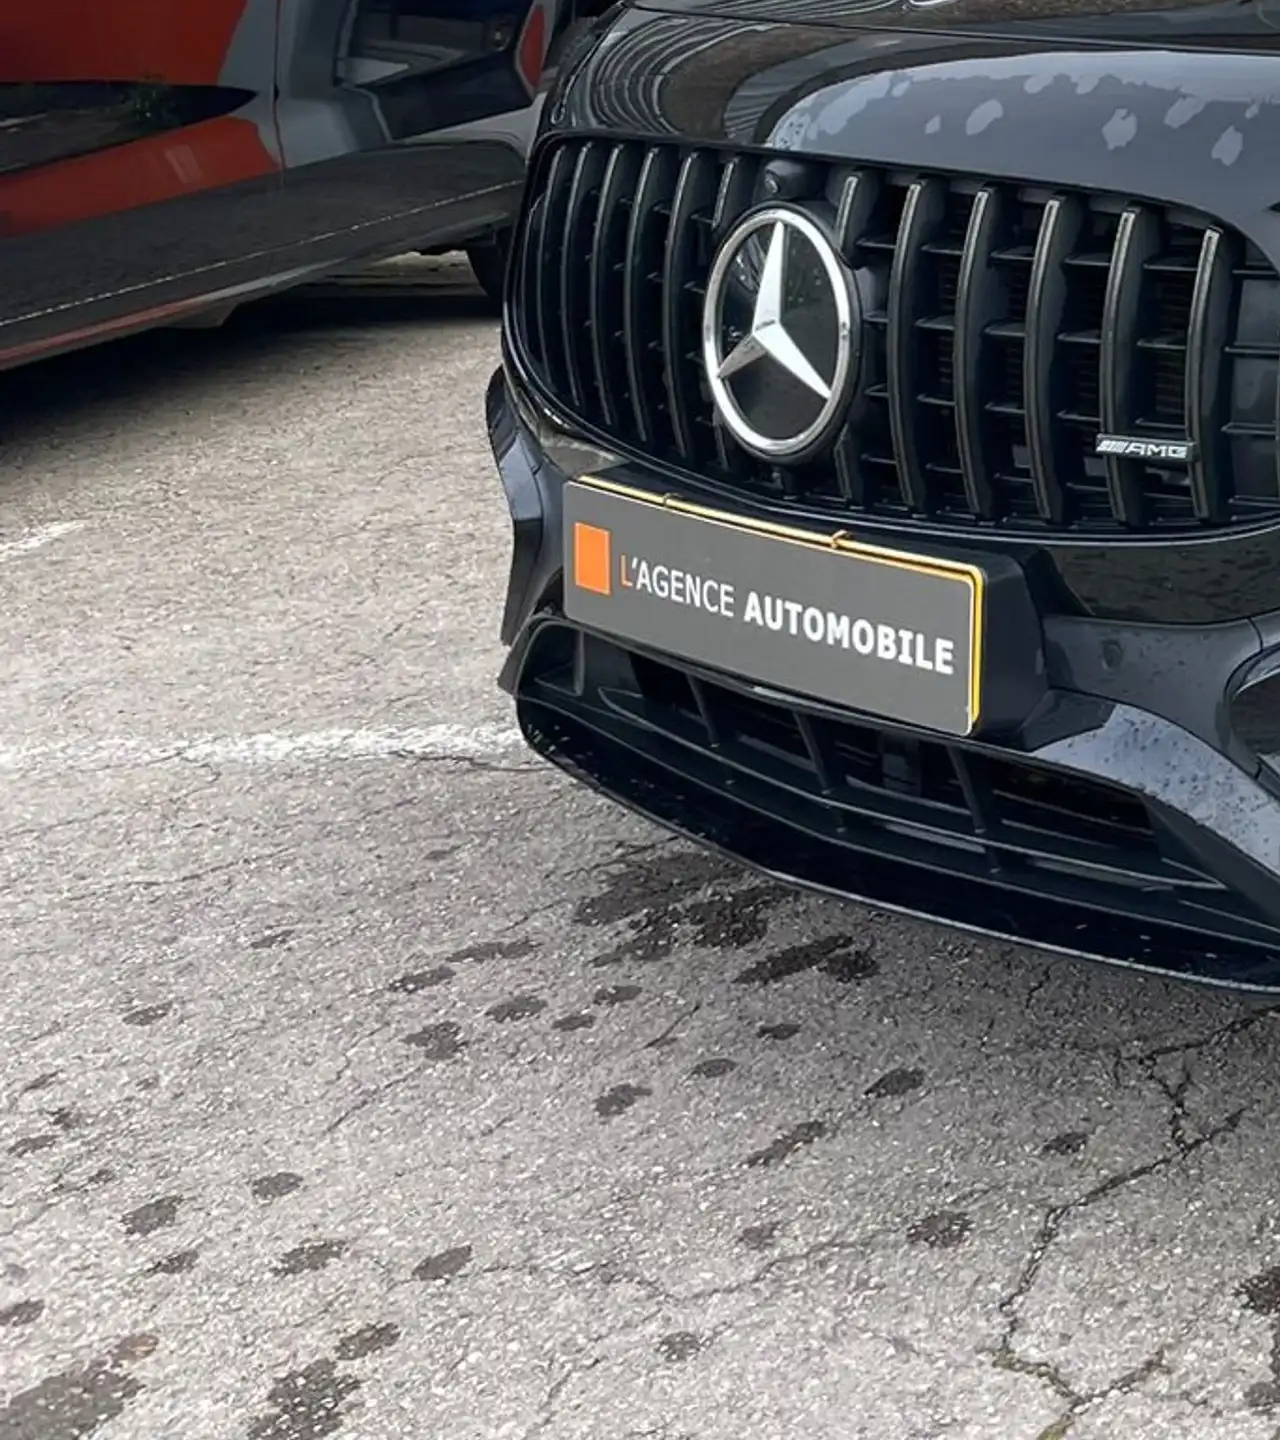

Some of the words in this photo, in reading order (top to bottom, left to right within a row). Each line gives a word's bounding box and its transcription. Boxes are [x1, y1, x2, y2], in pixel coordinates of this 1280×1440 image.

[1125, 441, 1187, 459] AMG
[620, 555, 735, 618] L'AGENCE
[743, 591, 955, 675] AUTOMOBILE
